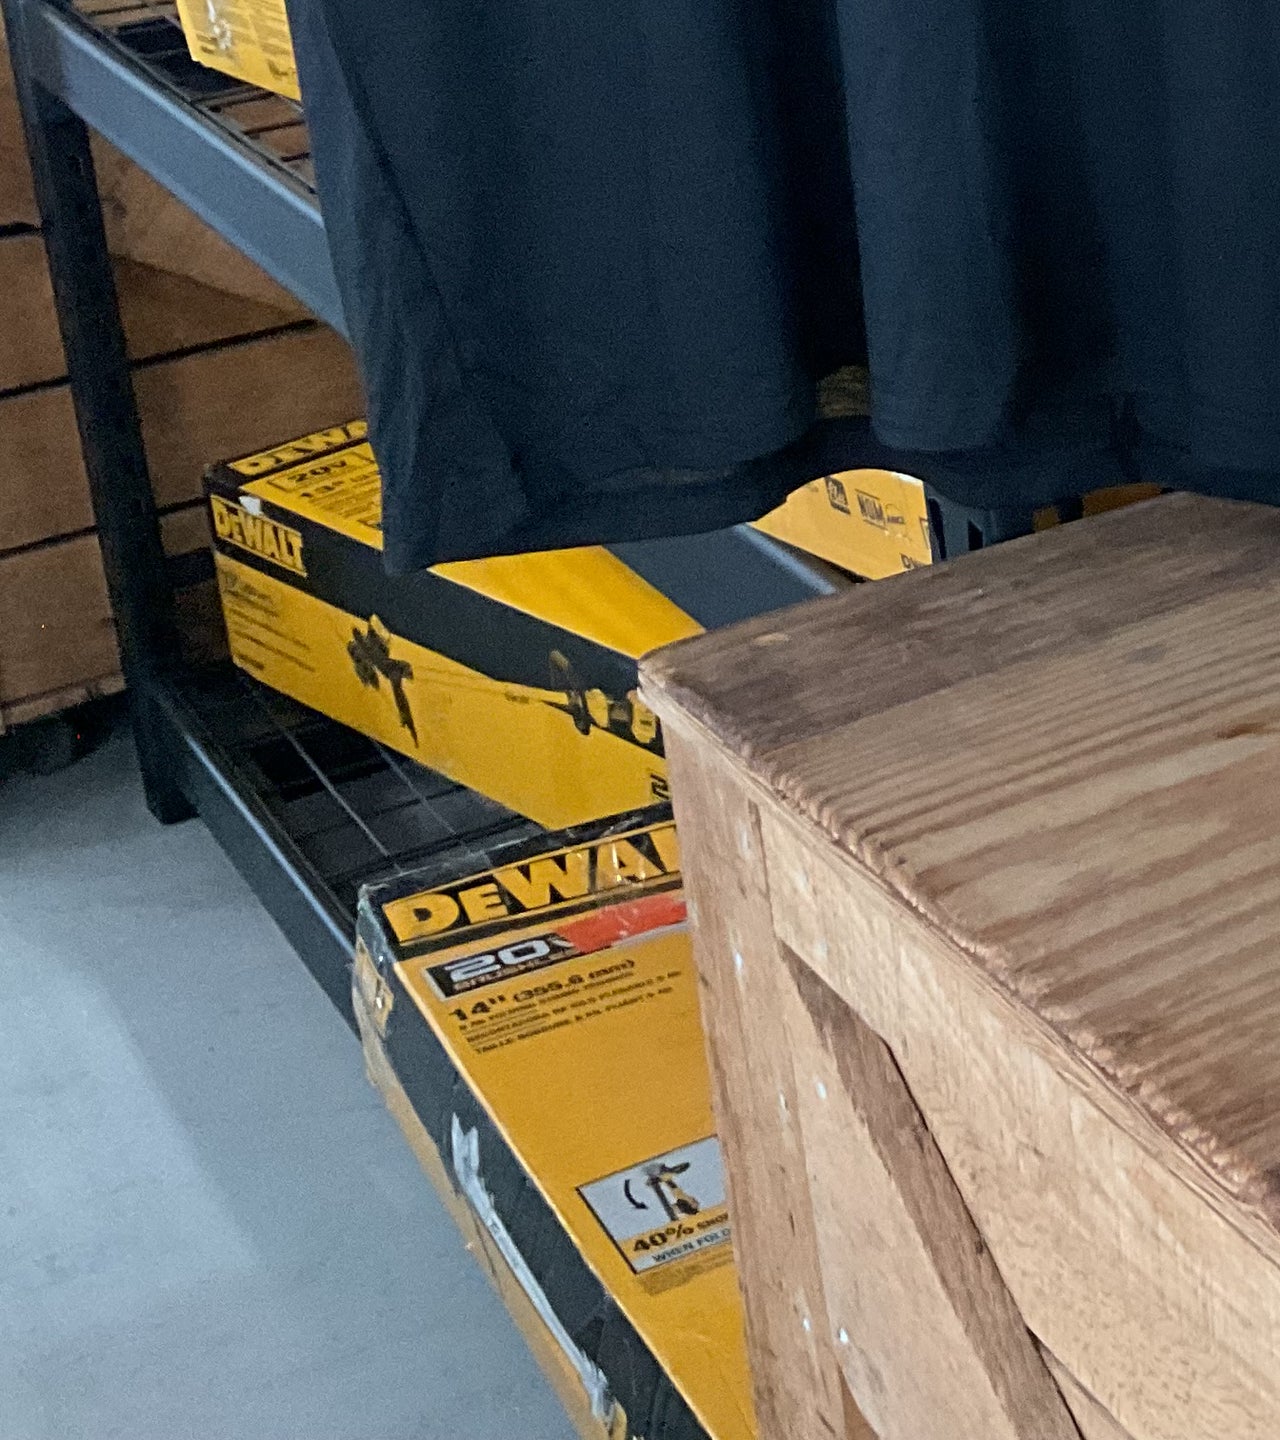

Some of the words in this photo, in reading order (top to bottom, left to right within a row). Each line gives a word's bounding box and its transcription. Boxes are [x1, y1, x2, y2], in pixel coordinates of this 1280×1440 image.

[212, 499, 304, 573] DEWALT
[385, 824, 682, 944] DEWA
[633, 1223, 695, 1252] 40%
